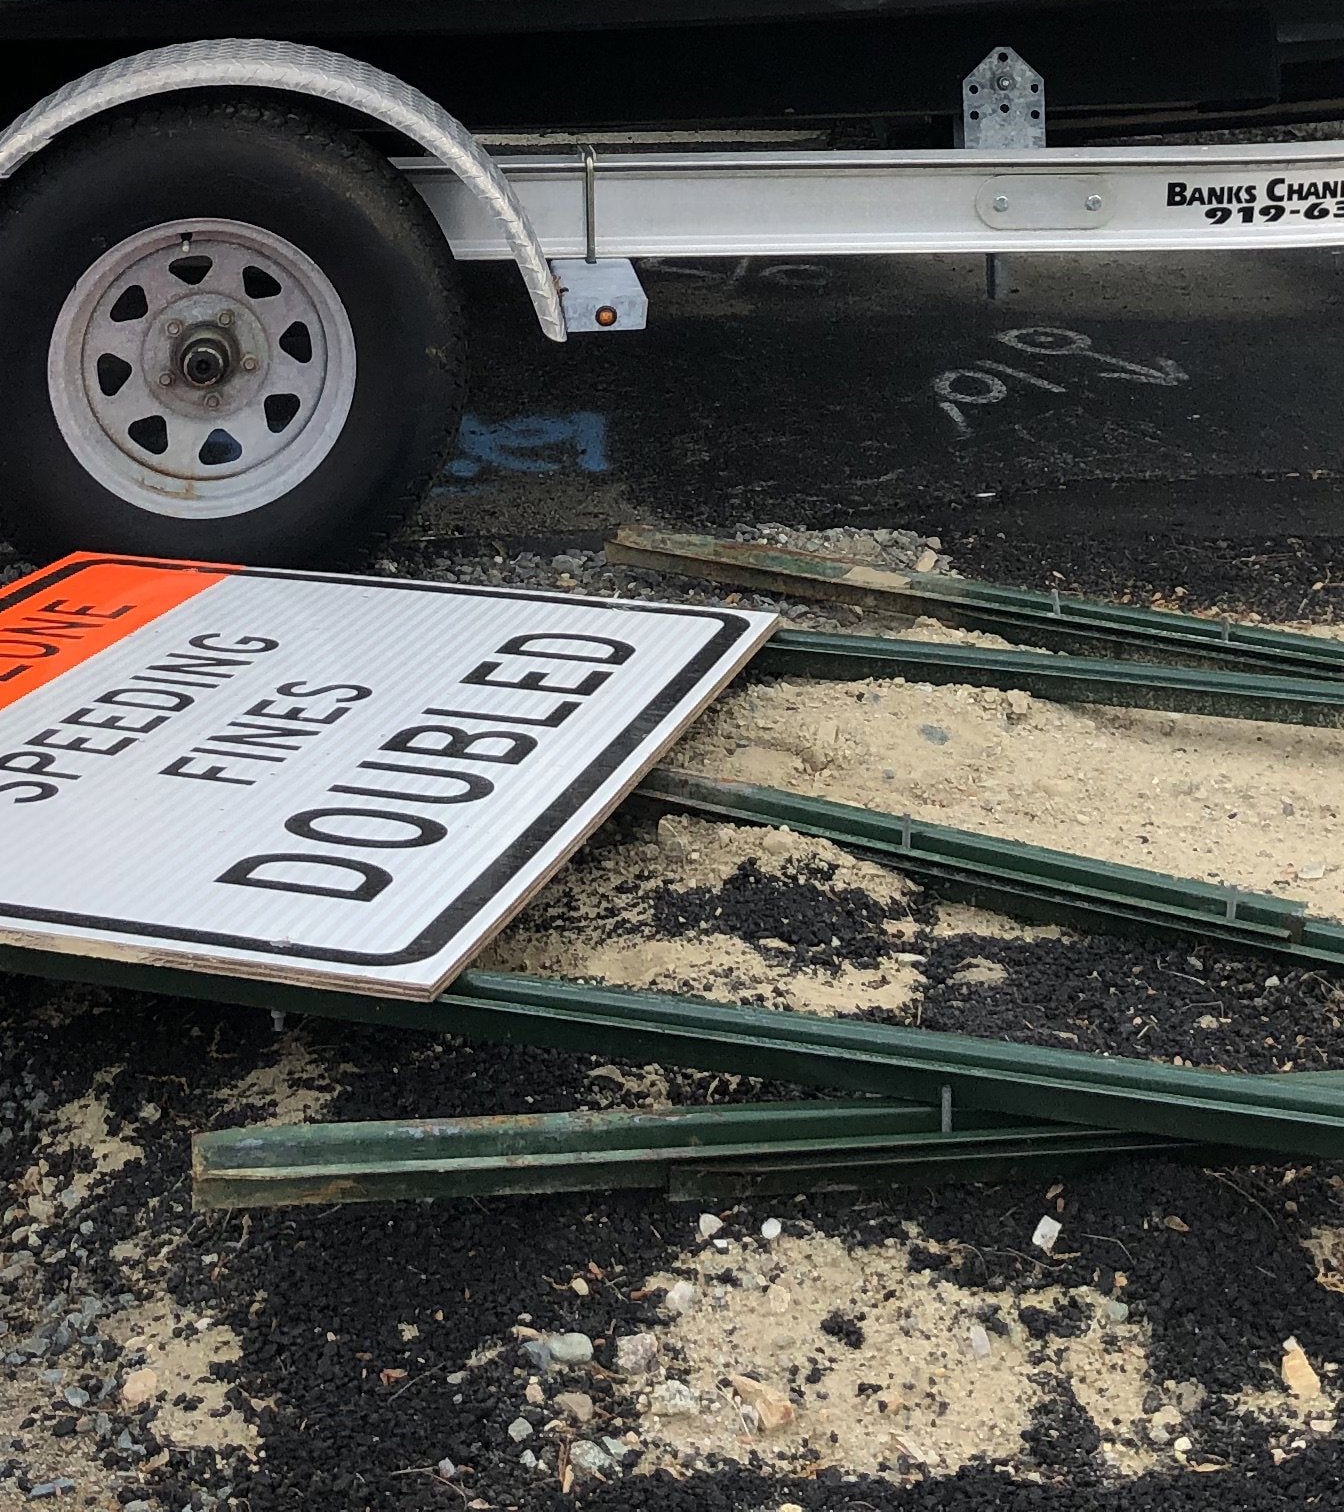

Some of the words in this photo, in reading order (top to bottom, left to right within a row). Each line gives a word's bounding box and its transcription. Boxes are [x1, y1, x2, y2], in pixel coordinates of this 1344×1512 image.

[1167, 181, 1256, 206] BANKS
[158, 680, 373, 786] FINES
[214, 632, 636, 902] DOUBLED
